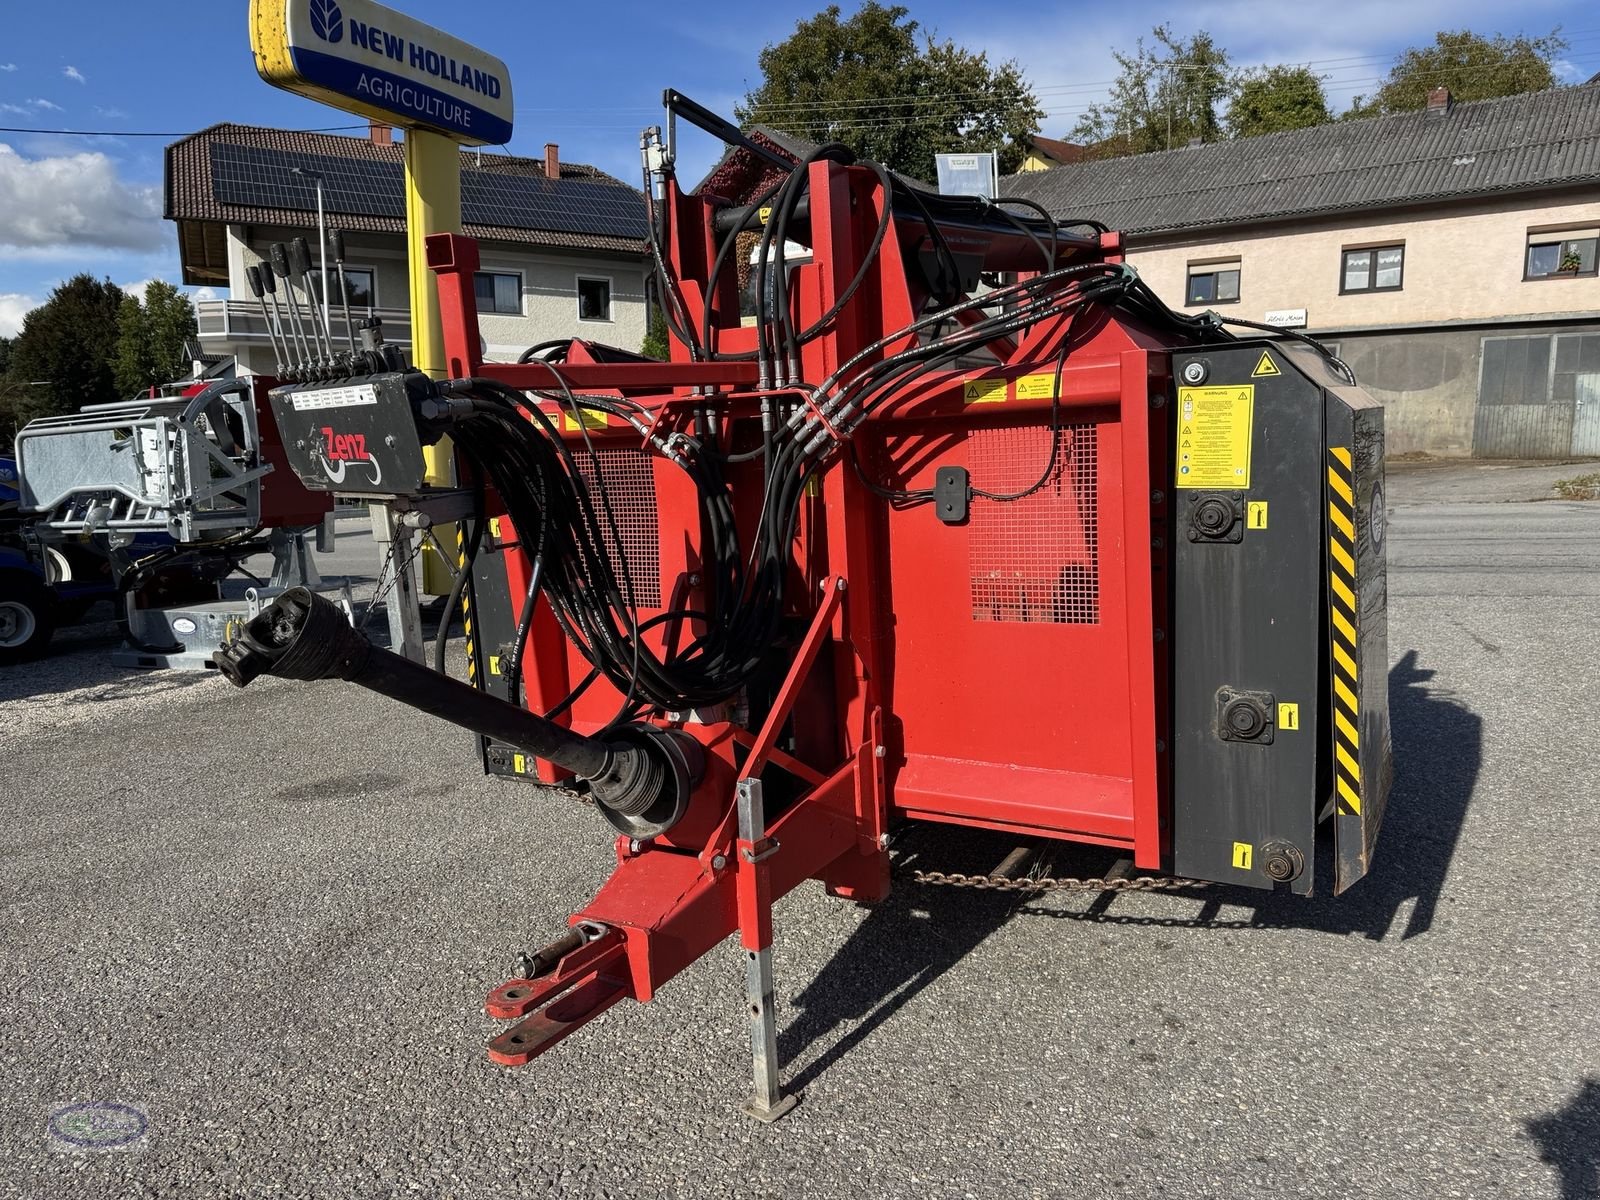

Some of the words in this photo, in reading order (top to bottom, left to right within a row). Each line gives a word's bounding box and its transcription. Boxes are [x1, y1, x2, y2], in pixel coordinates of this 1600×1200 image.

[350, 18, 404, 63] NEW
[409, 42, 501, 99] HOLLAND
[356, 73, 471, 128] AGRICULTURE
[321, 425, 370, 460] Zenz
